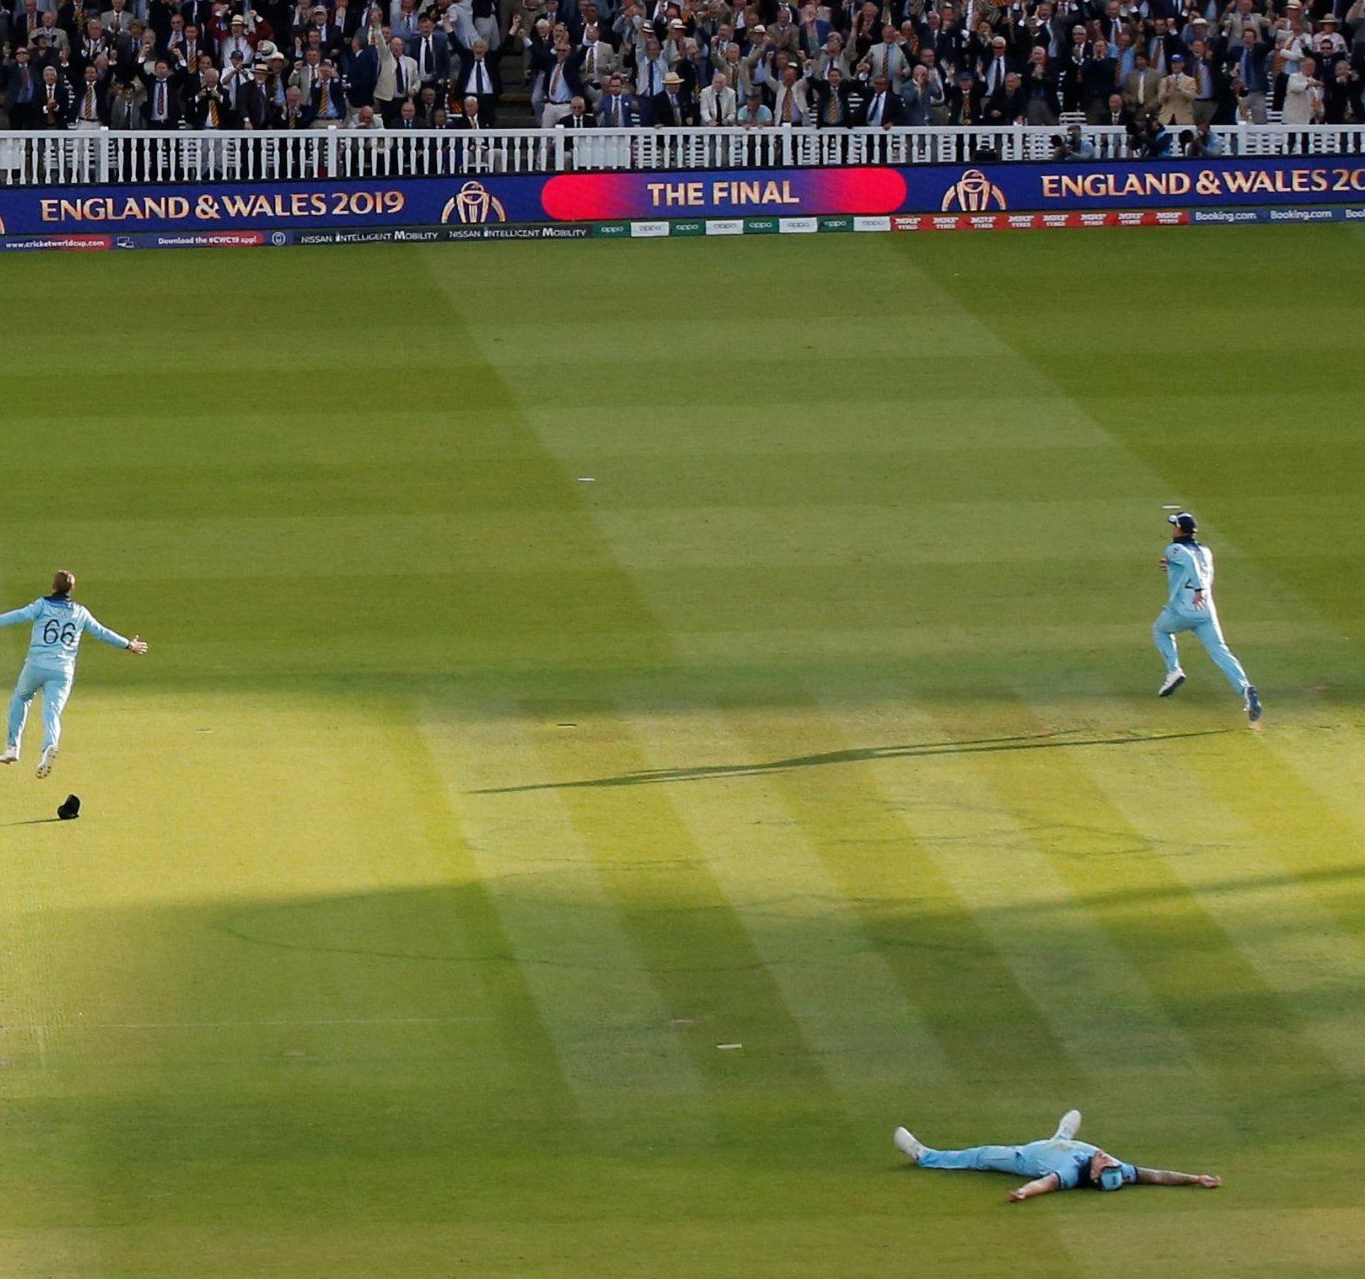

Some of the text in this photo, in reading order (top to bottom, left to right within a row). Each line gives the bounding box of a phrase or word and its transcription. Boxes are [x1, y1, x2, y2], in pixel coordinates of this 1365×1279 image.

[647, 180, 799, 206] THE FINAL
[1041, 172, 1191, 198] ENGLAND
[1222, 169, 1327, 193] WALES
[40, 196, 190, 221] ENGLAND
[220, 192, 326, 218] WALES
[331, 191, 405, 215] 2019
[1195, 210, 1256, 221] Booking.com
[1270, 209, 1332, 220] Booking.com
[43, 619, 76, 647] 66
